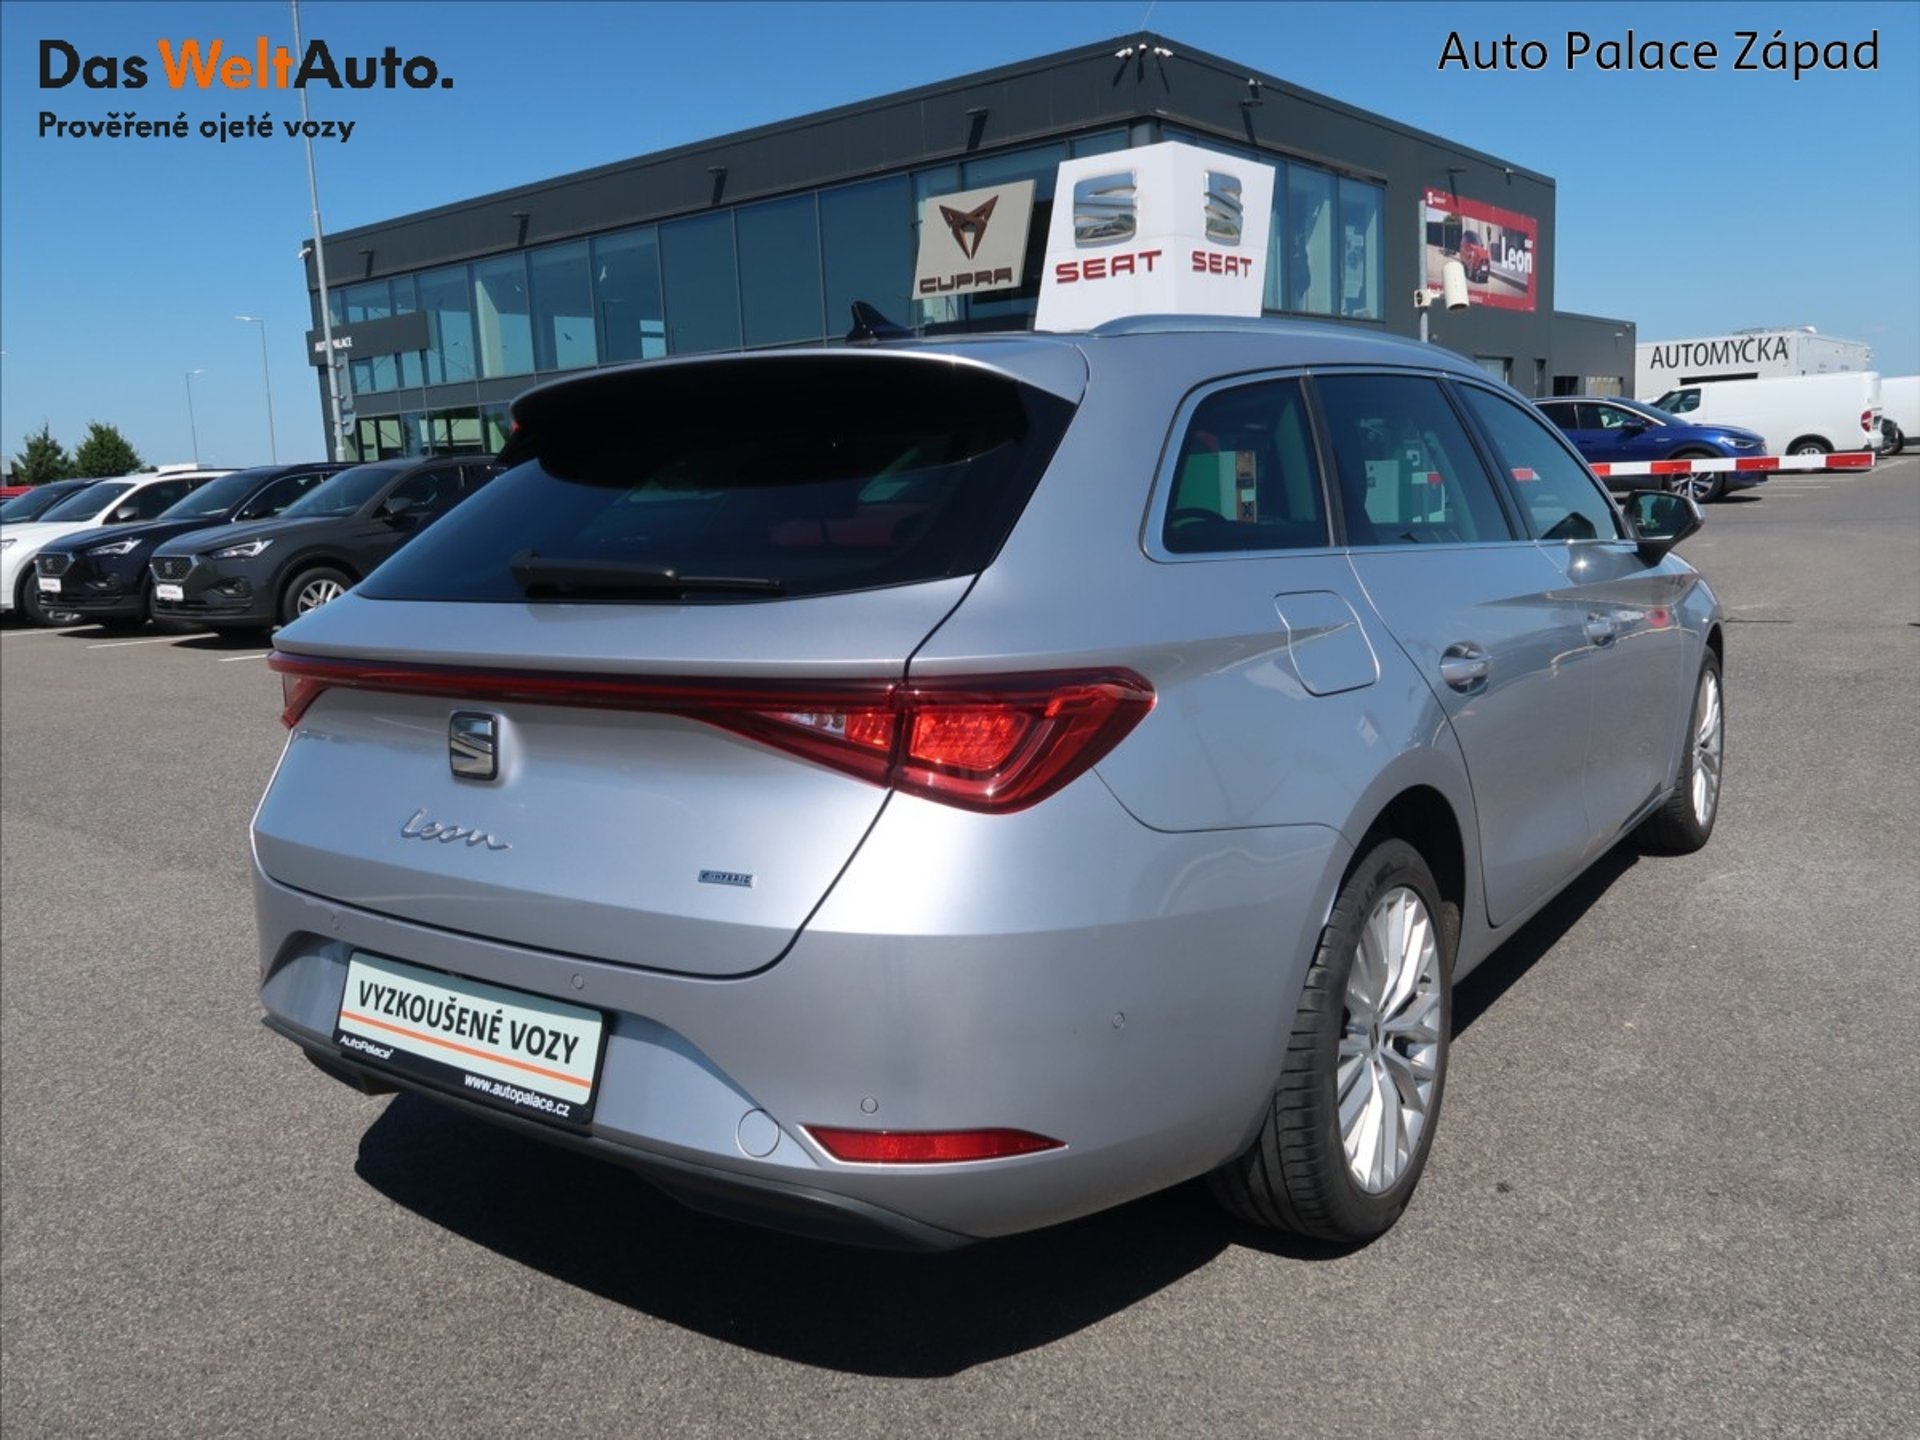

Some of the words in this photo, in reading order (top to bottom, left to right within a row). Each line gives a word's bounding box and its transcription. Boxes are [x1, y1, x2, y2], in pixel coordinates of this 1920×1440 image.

[1055, 250, 1162, 284] SEAT
[1191, 250, 1252, 279] SEAT
[1501, 236, 1532, 274] Leon
[920, 267, 1012, 293] CUPRA
[1650, 335, 1788, 369] AUTOMYČKA
[401, 808, 512, 850] Leon
[359, 979, 503, 1046] VYZKOUŠENÉ
[510, 1019, 579, 1065] VOZY
[464, 1073, 571, 1117] www.autopalace.cz
